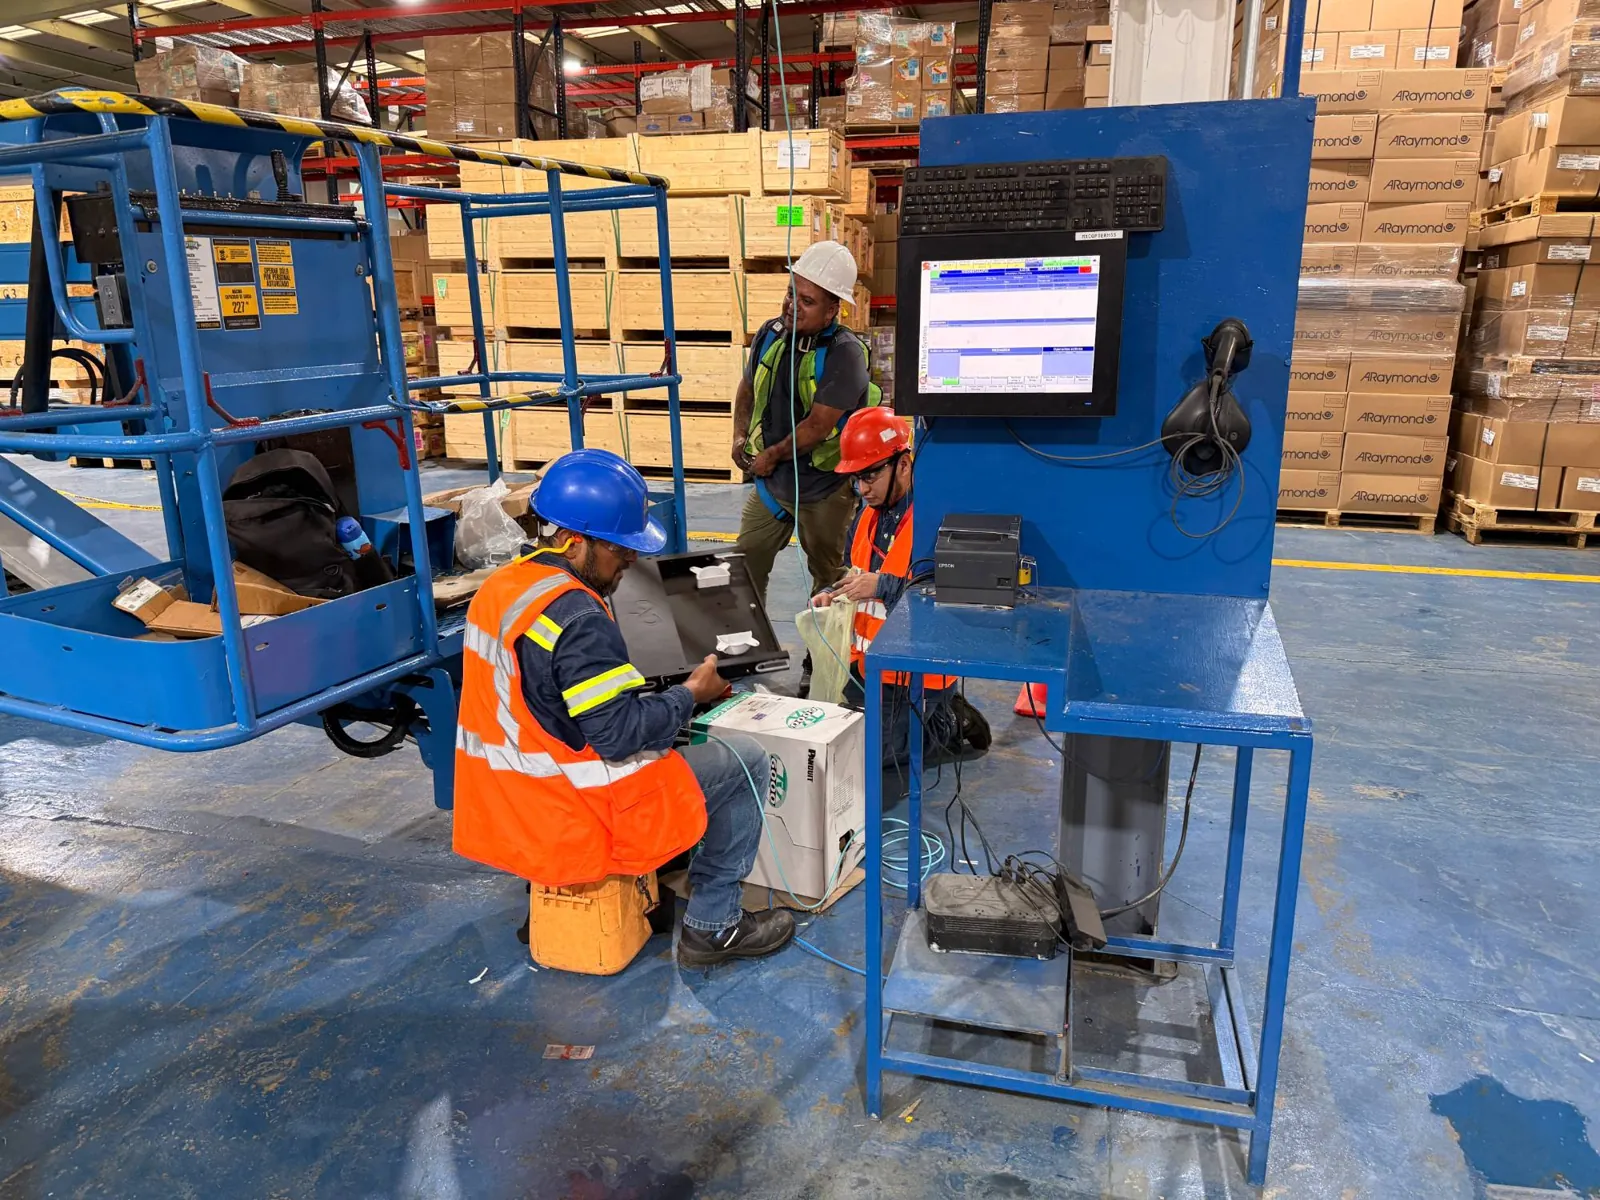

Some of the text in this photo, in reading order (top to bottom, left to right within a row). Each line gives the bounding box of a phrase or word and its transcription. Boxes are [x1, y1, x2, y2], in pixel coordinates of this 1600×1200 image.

[1391, 90, 1463, 103] ARaymond
[1313, 136, 1350, 147] mond
[1389, 134, 1459, 148] ARaymond
[1383, 178, 1453, 192] ARaymond
[1304, 223, 1338, 233] mond
[1375, 222, 1444, 235] ARaymond
[232, 301, 245, 313] 227
[1289, 370, 1324, 380] mond
[1360, 371, 1428, 385] ARaymond
[1356, 411, 1424, 425] ARaymond
[1354, 451, 1422, 465] ARaymond
[1350, 489, 1417, 504] ARaymond
